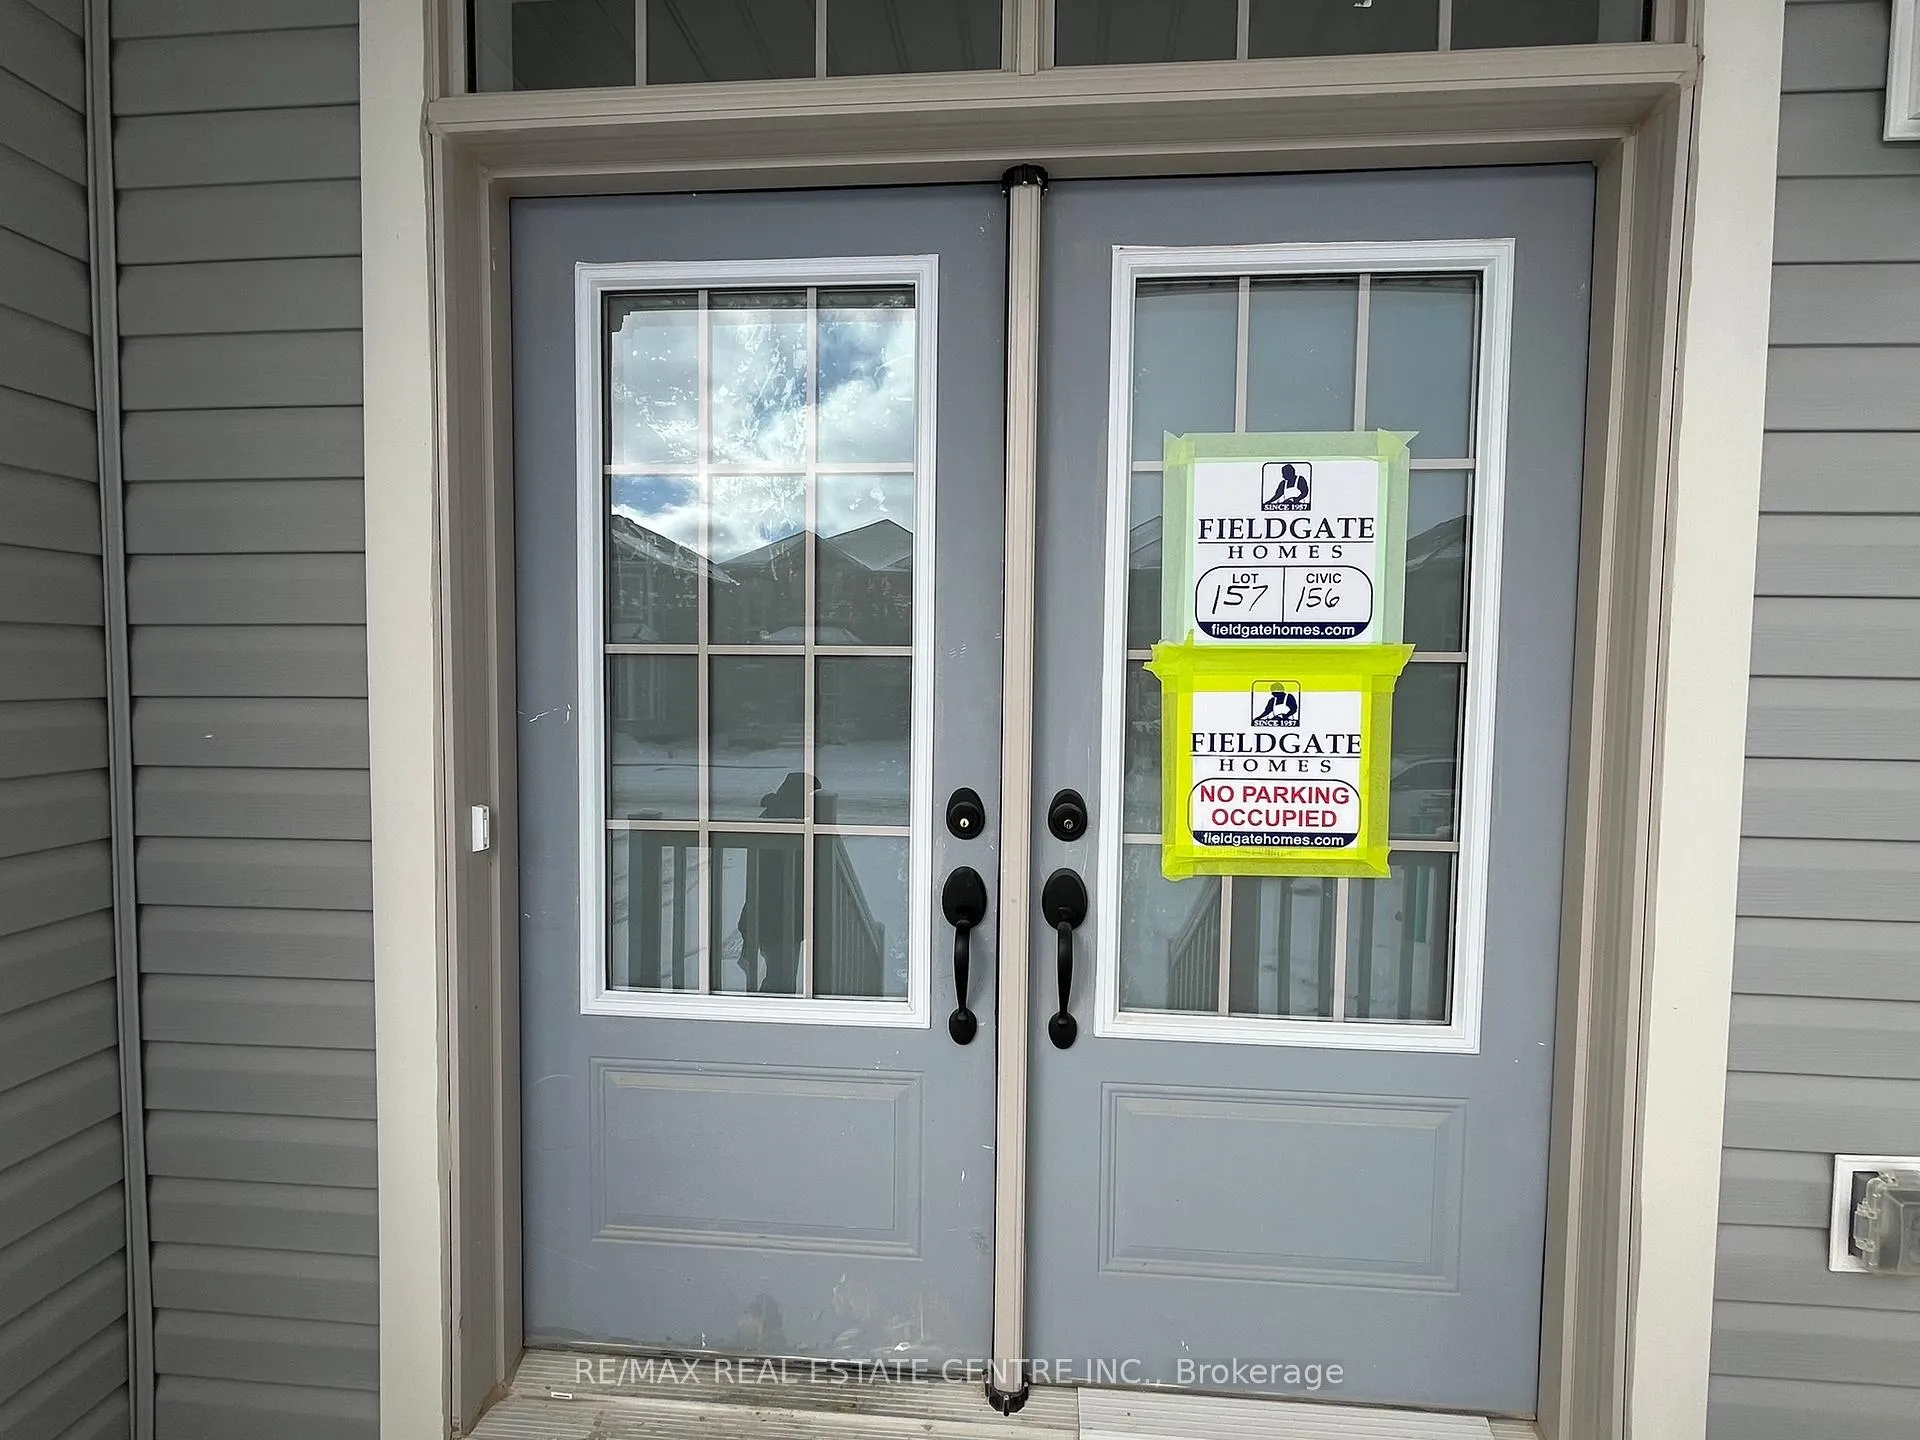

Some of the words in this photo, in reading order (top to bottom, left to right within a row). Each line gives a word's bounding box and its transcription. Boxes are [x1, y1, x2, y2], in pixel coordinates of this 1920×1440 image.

[1263, 503, 1290, 511] SINCE
[1198, 517, 1375, 540] FIELDGATE
[1228, 545, 1343, 559] HOMES
[1232, 573, 1259, 584] LOT
[1306, 573, 1342, 584] CIVIC
[1211, 584, 1269, 615] 157
[1296, 586, 1341, 613] 156
[1211, 623, 1355, 638] fieldgatehomes.com
[1254, 719, 1279, 727] SINCE
[1190, 732, 1362, 754] FIELDGATE
[1219, 758, 1332, 773] HOMES
[1200, 785, 1234, 803] NO
[1242, 786, 1350, 804] PARKING
[1211, 808, 1338, 827] OCCUPIED
[1203, 831, 1345, 847] fieldgatehomes.com
